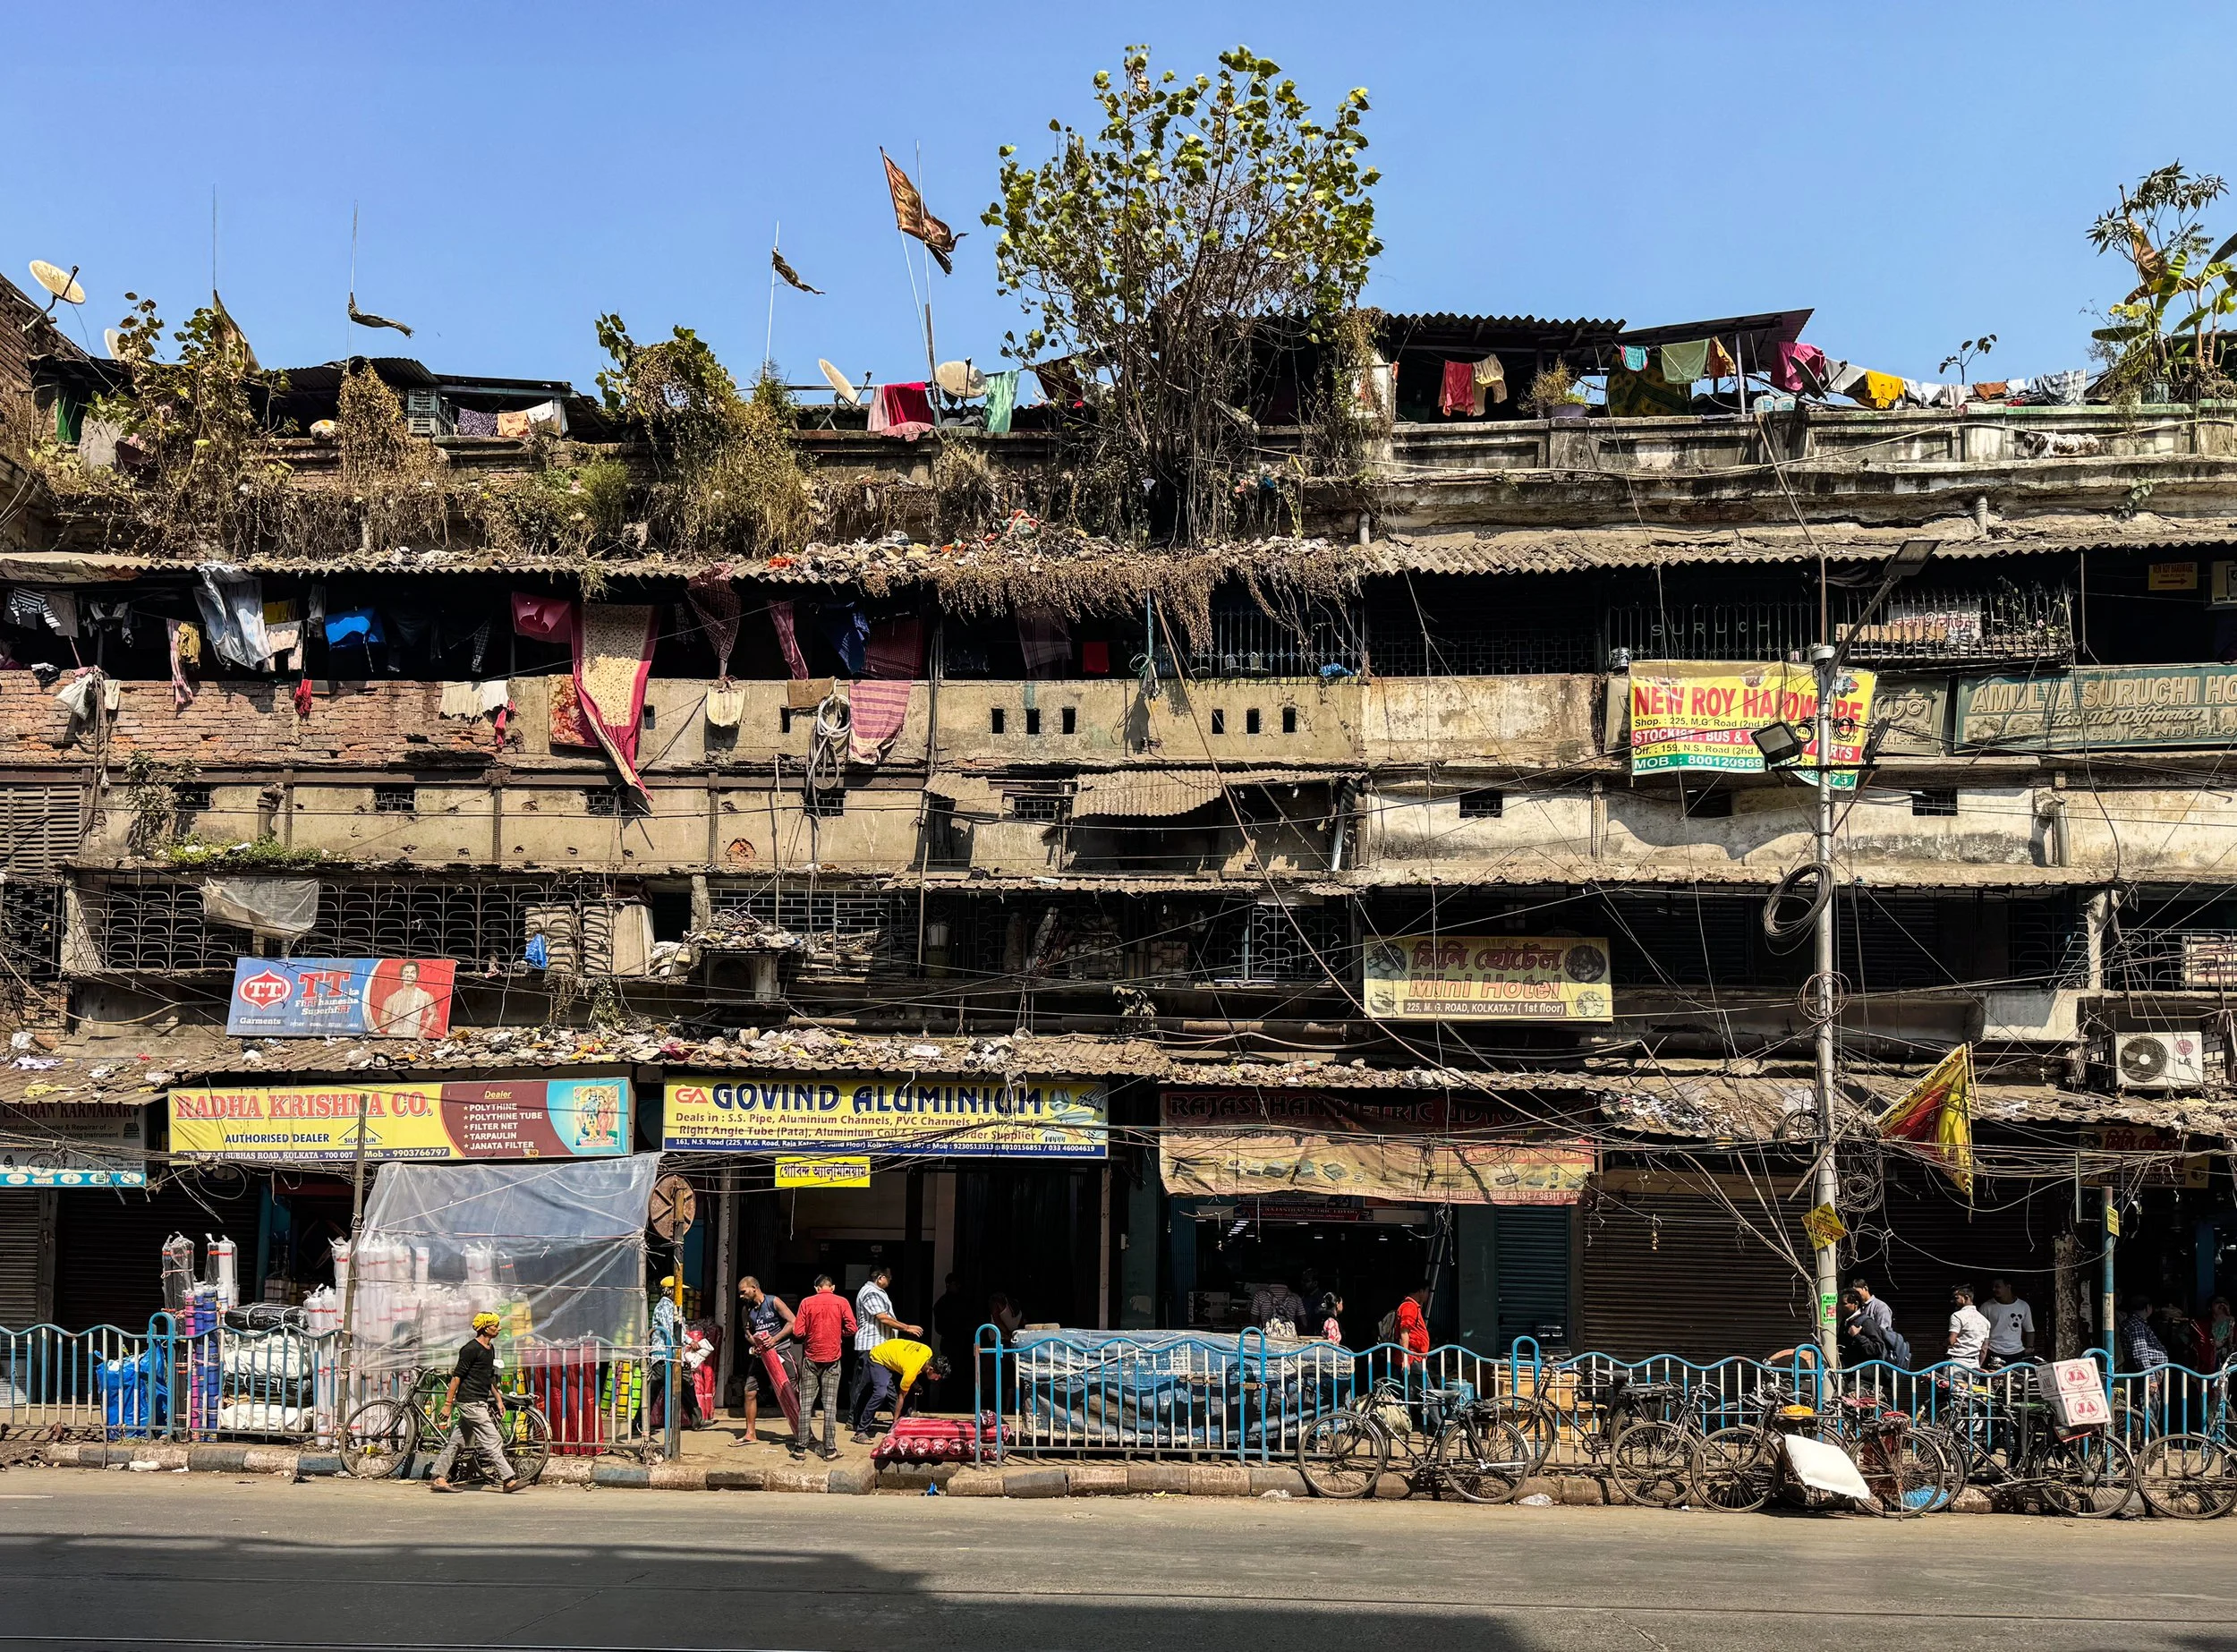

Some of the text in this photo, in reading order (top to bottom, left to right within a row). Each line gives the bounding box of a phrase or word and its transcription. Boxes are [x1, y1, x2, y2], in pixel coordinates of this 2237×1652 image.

[1970, 683, 2078, 713] AMULYA
[2081, 676, 2199, 707] SURUCHI
[1634, 686, 1685, 717] NEW
[1691, 687, 1737, 718] ROY
[1634, 719, 1662, 728] Shop.
[1670, 718, 1688, 727] 225,
[1714, 719, 1737, 728] Road
[2118, 705, 2202, 728] Difference
[1634, 728, 1694, 744] STOCKIST
[1705, 729, 1730, 743] BUS
[1661, 744, 1680, 753] 159,
[1705, 745, 1730, 754] Road
[1732, 745, 1754, 755] (2nd
[1634, 755, 1673, 770] MOB.
[1411, 940, 1563, 971] মিনি হোটেল
[249, 982, 282, 998] T.T.
[1408, 972, 1561, 1000] Mini Hotel
[1406, 1002, 1421, 1013] 225,
[1424, 1002, 1432, 1012] M.
[1434, 1002, 1442, 1012] G.
[1443, 1002, 1469, 1014] ROAD,
[1472, 1002, 1515, 1013] KOLKATA-7
[1540, 1002, 1564, 1015] floor)
[239, 1017, 282, 1026] Garments
[2177, 1057, 2191, 1066] LG
[484, 1090, 513, 1099] Dealer
[674, 1082, 1044, 1116] GA GOVIND ALUMINIUM
[3, 1102, 132, 1119] CHARAN KARMAKAR
[175, 1094, 264, 1120] RADHA
[390, 1091, 433, 1118] CO.
[469, 1103, 518, 1111] POLYTHINE
[1170, 1094, 1328, 1119] RAJASTHAN
[519, 1111, 543, 1120] TUBE
[676, 1112, 704, 1122] Deals
[708, 1112, 719, 1122] in
[727, 1113, 746, 1123] S.S.
[749, 1113, 775, 1125] Pipe,
[778, 1114, 838, 1124] Aluminium
[840, 1115, 893, 1126] Channels,
[896, 1116, 917, 1125] PVC
[469, 1122, 499, 1130] FILTER
[225, 1133, 329, 1145] AUTHORISED DEALER
[469, 1132, 517, 1140] TARPAULIN
[679, 1125, 709, 1137] Right
[711, 1126, 744, 1137] Angle
[747, 1126, 774, 1136] Tube
[777, 1127, 812, 1138] (Pata),
[814, 1128, 873, 1137] Aluminium
[991, 1130, 1035, 1142] Supplier
[470, 1141, 534, 1150] JANATA FILTER
[1048, 1144, 1060, 1152] 033
[225, 1151, 256, 1160] SUBHAS
[257, 1152, 281, 1161] ROAD,
[282, 1151, 319, 1160] KOLKATA
[339, 1151, 353, 1159] 007
[364, 1150, 384, 1158] Mob
[392, 1148, 447, 1157] 9903766797
[779, 1162, 810, 1178] গোবিন্দ
[2068, 1369, 2087, 1383] JA
[2077, 1401, 2097, 1414] JA
